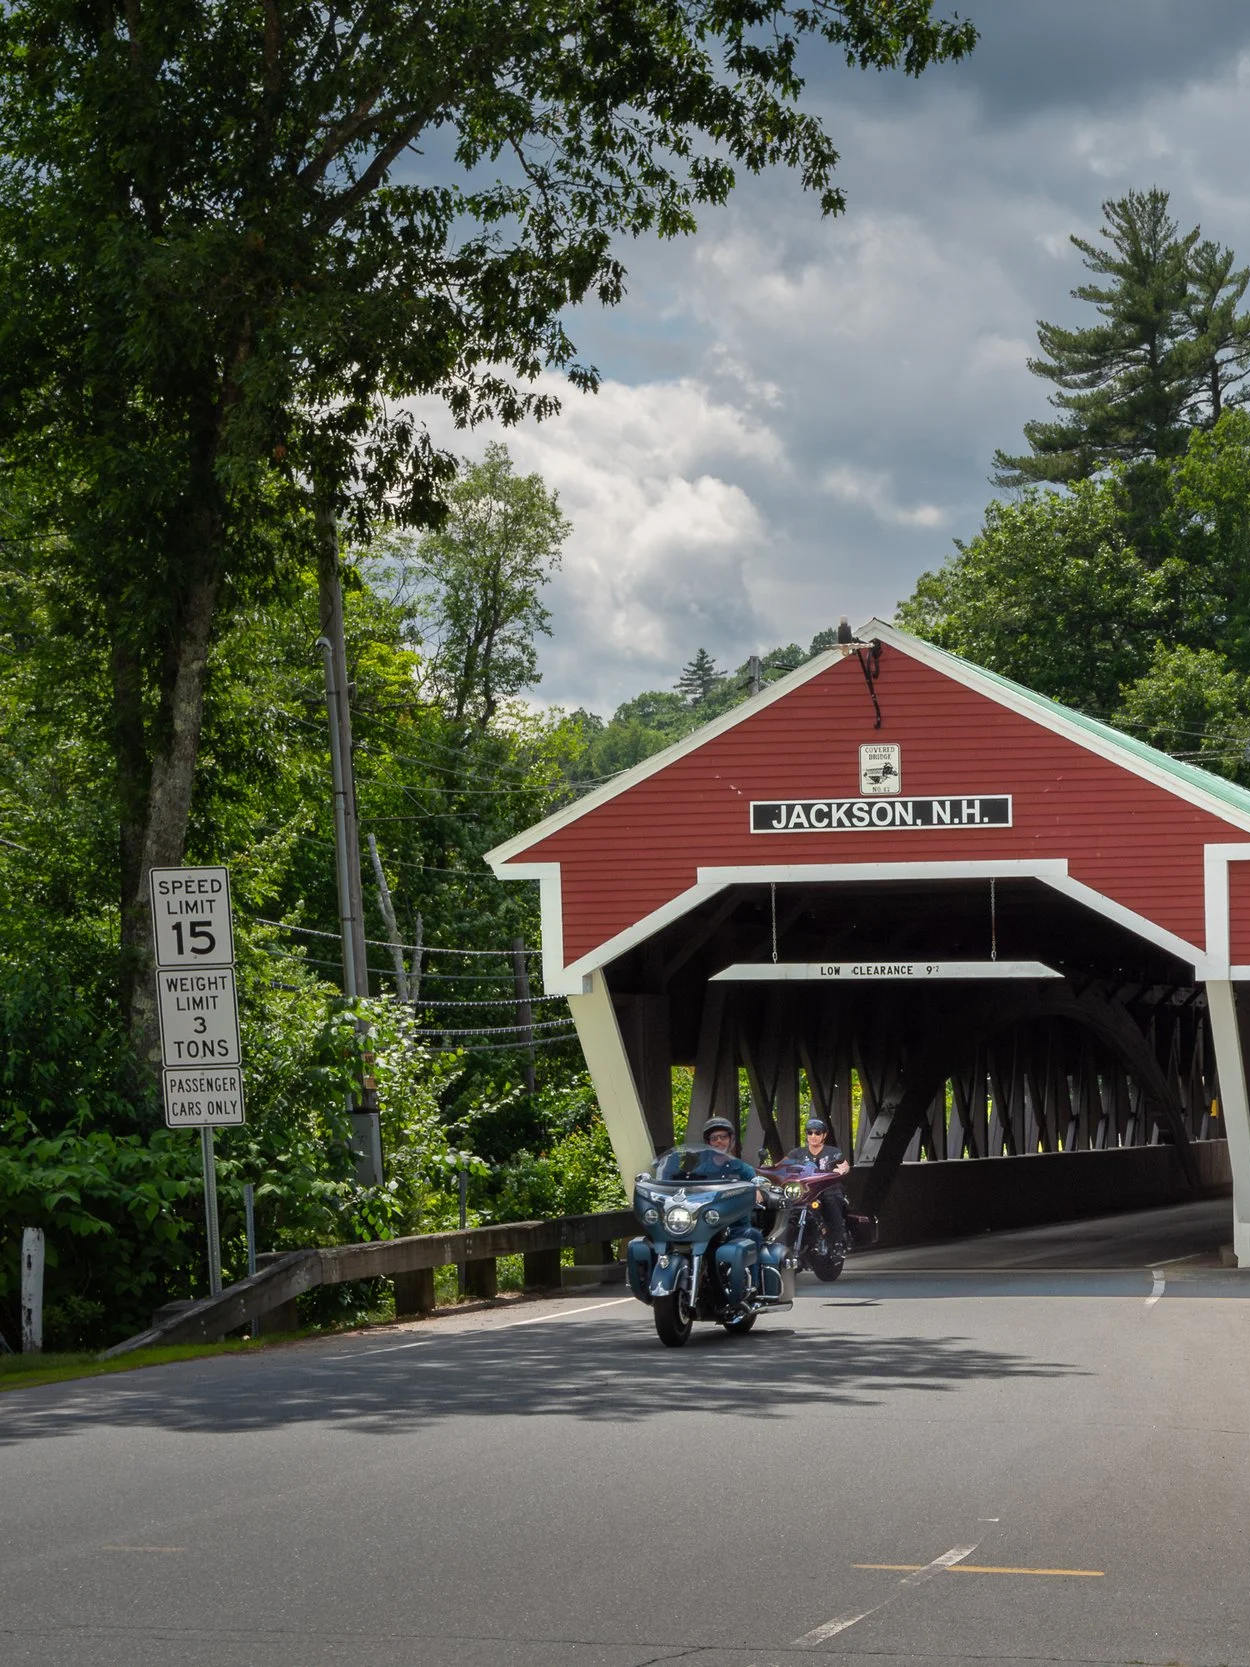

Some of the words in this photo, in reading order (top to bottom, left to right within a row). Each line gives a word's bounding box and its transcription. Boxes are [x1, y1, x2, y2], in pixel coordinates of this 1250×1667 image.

[771, 801, 922, 828] JACKSON,
[932, 799, 989, 825] N.H.
[158, 879, 222, 895] SPEED
[167, 899, 216, 915] LIMIT
[172, 920, 216, 955] 15
[820, 966, 841, 976] LOW
[853, 965, 914, 976] CLEARANCE
[166, 975, 228, 993] WEIGHT
[176, 996, 219, 1011] LIMIT
[194, 1016, 207, 1034] 3
[173, 1040, 229, 1059] TONS
[170, 1077, 237, 1094] PASSENGER
[172, 1101, 202, 1116] CARS
[207, 1100, 238, 1116] ONLY
